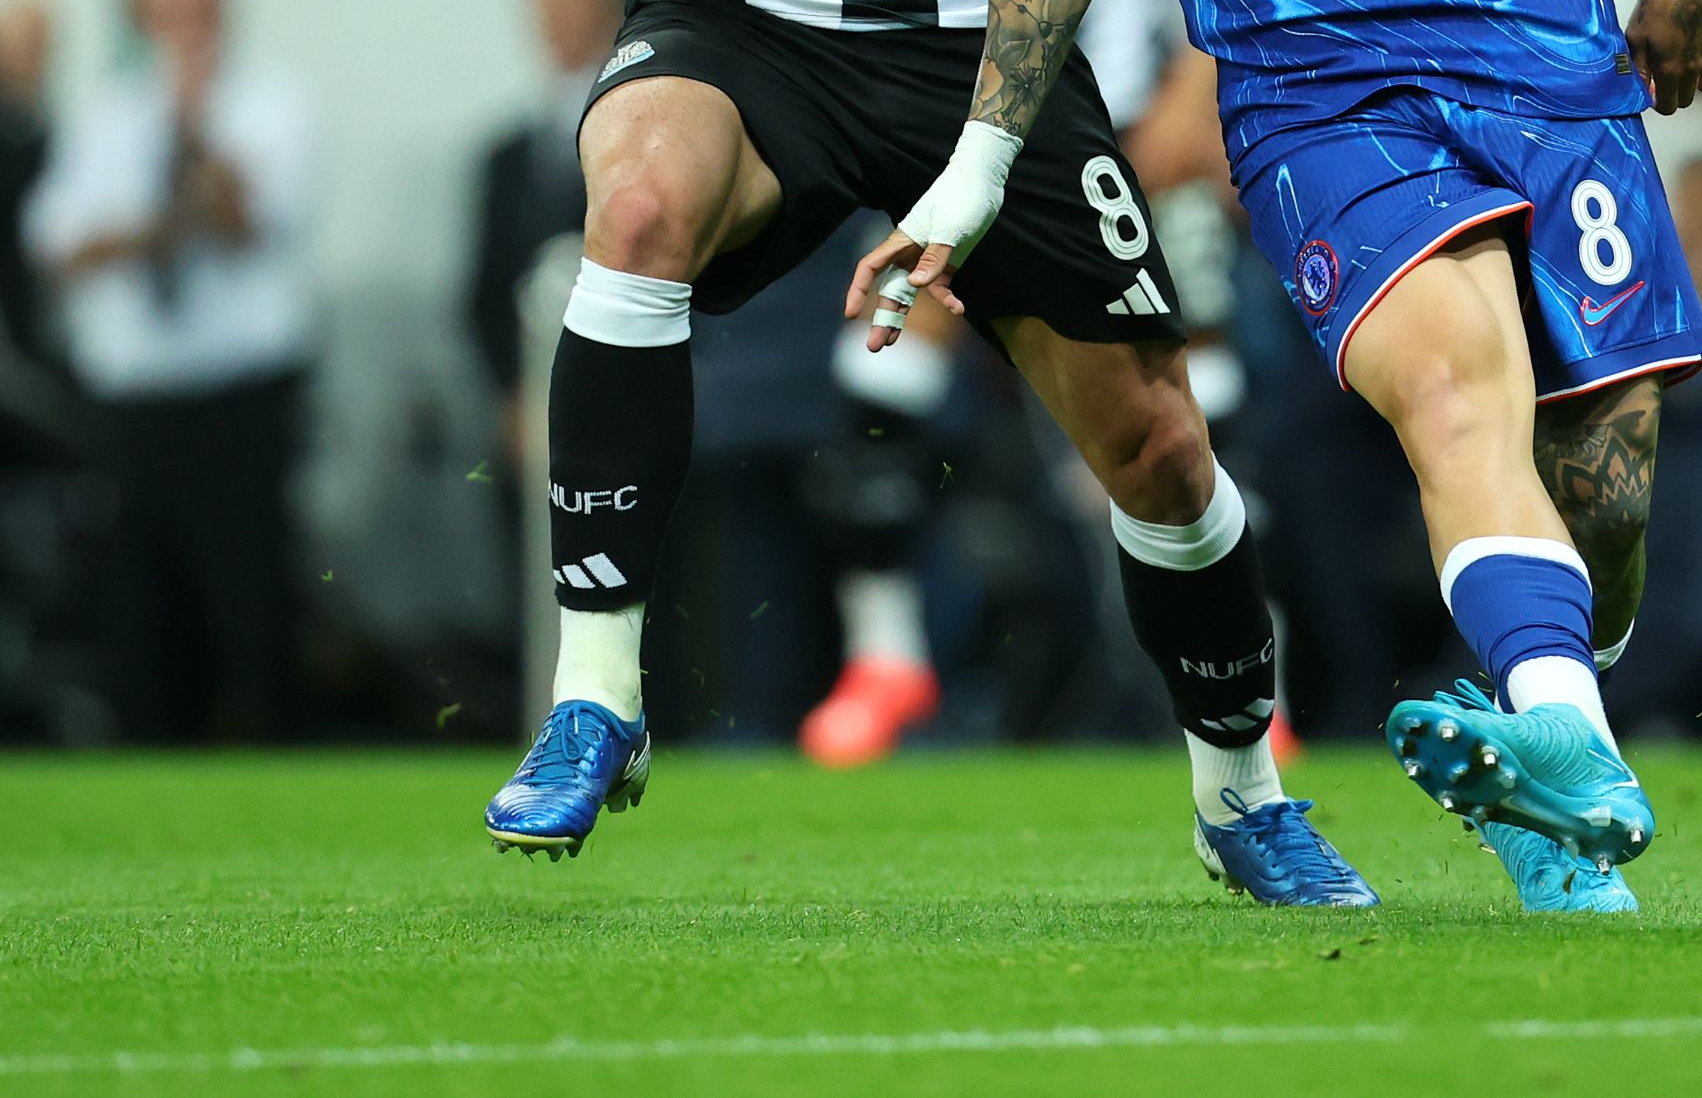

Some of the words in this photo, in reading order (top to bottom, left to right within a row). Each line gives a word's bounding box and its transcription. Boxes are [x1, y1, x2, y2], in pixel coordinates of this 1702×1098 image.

[1081, 155, 1149, 260] 8
[1571, 180, 1632, 285] 8
[549, 479, 638, 515] NUFC
[1180, 638, 1272, 679] NUFC
